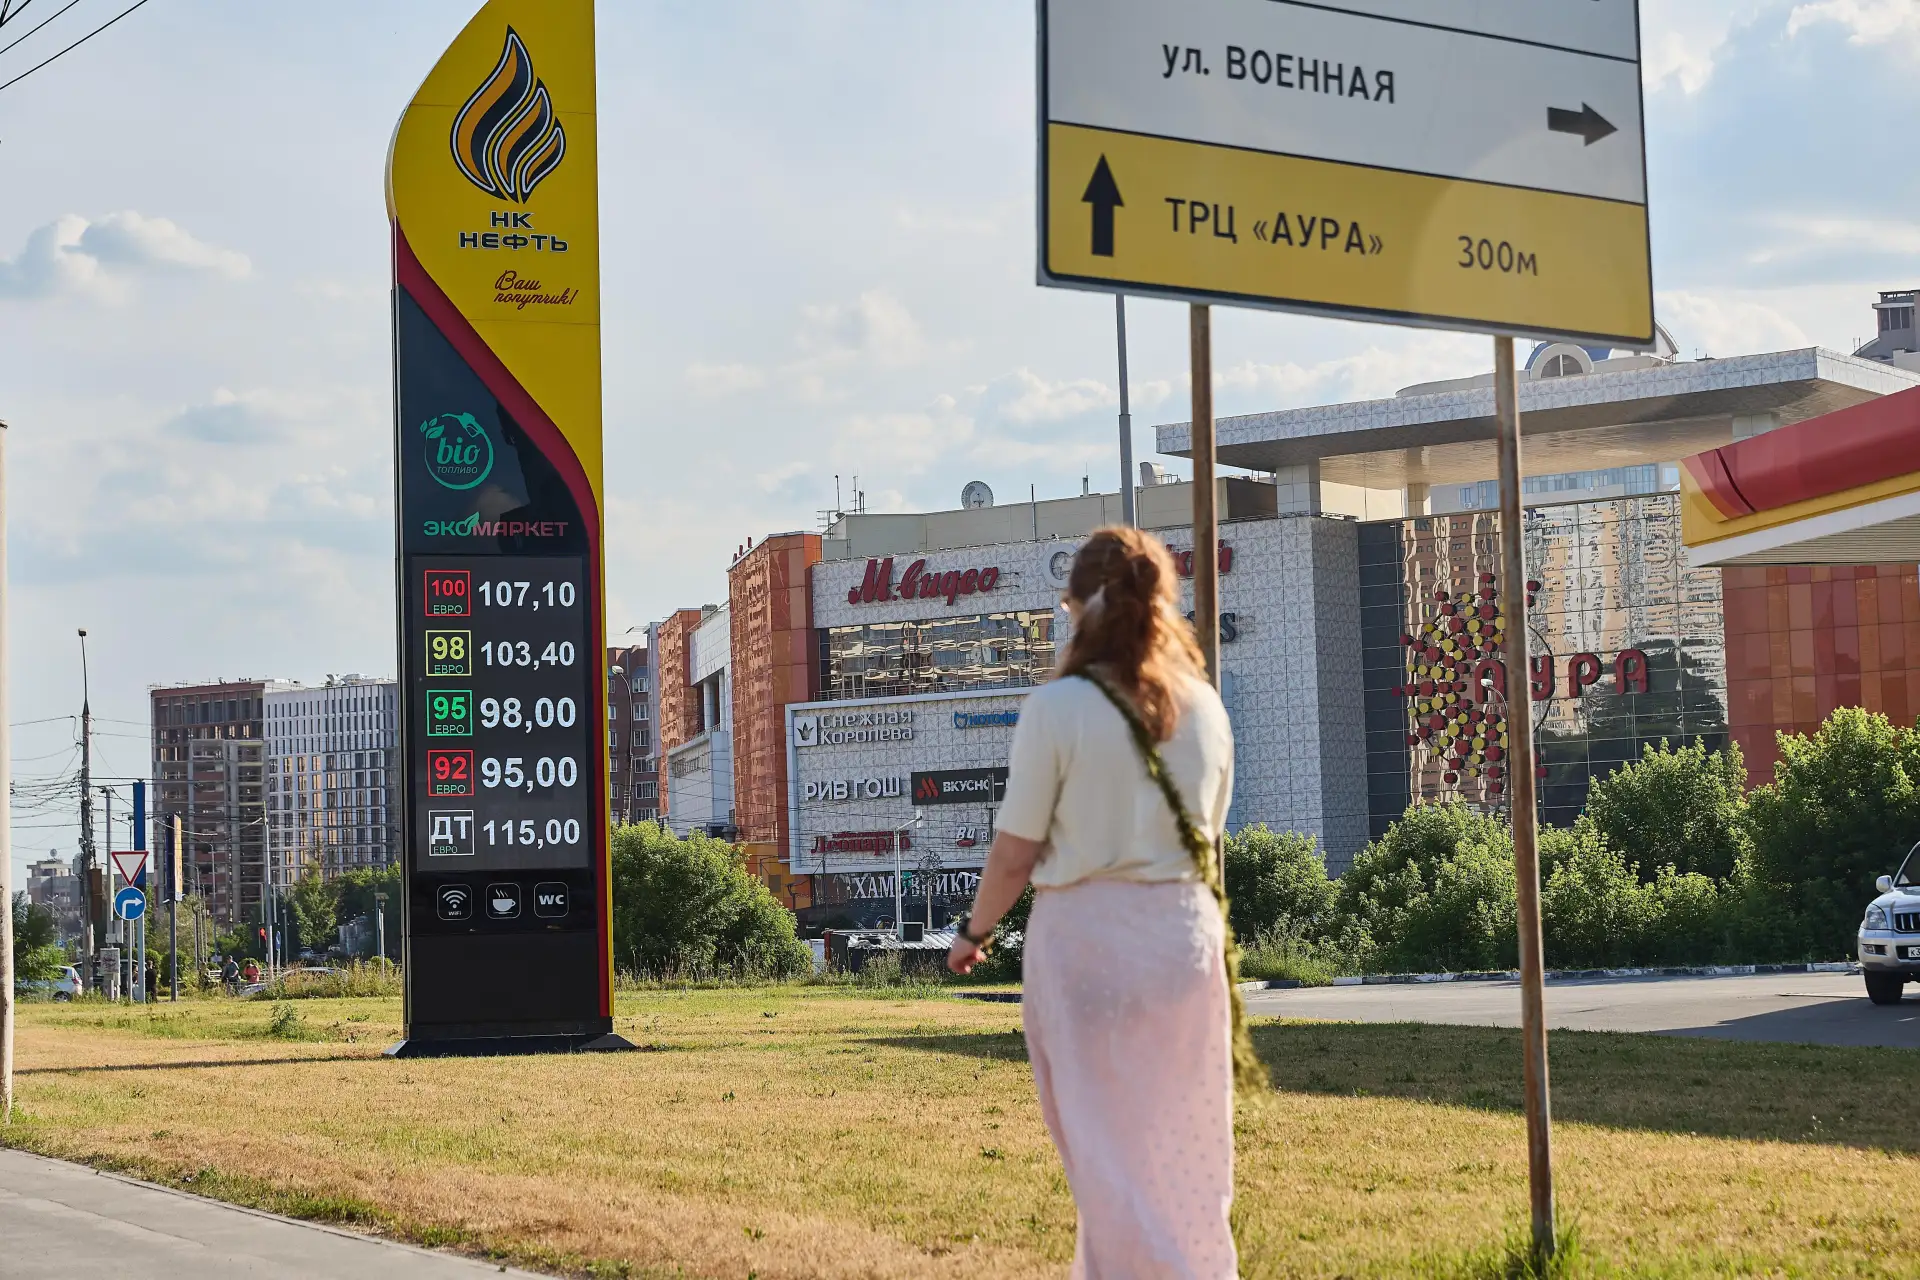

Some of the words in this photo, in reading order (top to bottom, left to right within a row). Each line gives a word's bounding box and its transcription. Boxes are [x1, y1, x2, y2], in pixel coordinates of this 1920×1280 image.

[1162, 43, 1210, 79] ул.
[1226, 45, 1395, 104] ВОЕННАЯ
[490, 211, 535, 229] НК
[458, 231, 569, 253] НЕФТЬ
[1165, 197, 1237, 244] ТРЦ
[1252, 211, 1383, 256] «АУРА»
[1457, 235, 1538, 277] 300м
[494, 269, 541, 291] Ваш
[436, 436, 481, 464] bio
[436, 466, 478, 474] ТОПЛИВО
[423, 518, 569, 537] ЭКОМАРКЕТ
[847, 557, 999, 607] М.видео
[431, 579, 466, 597] 100
[478, 581, 576, 612] 107,10
[433, 604, 463, 615] ЕВРО
[432, 636, 465, 660] 98
[480, 641, 575, 671] 103,40
[434, 664, 464, 675] ЕВРО
[433, 696, 467, 720] 95
[480, 697, 576, 734] 98,00
[820, 709, 912, 729] Снежная
[435, 724, 465, 734] ЕВРО
[820, 727, 913, 745] Королева
[434, 756, 467, 780] 92
[481, 756, 577, 793] 95,00
[436, 784, 466, 795] ЕВРО
[804, 780, 849, 801] РИВ
[853, 776, 901, 799] ГОШ
[431, 816, 472, 844] ДТ
[483, 818, 580, 850] 115,00
[433, 845, 458, 854] ЕВРО
[539, 894, 565, 905] WC
